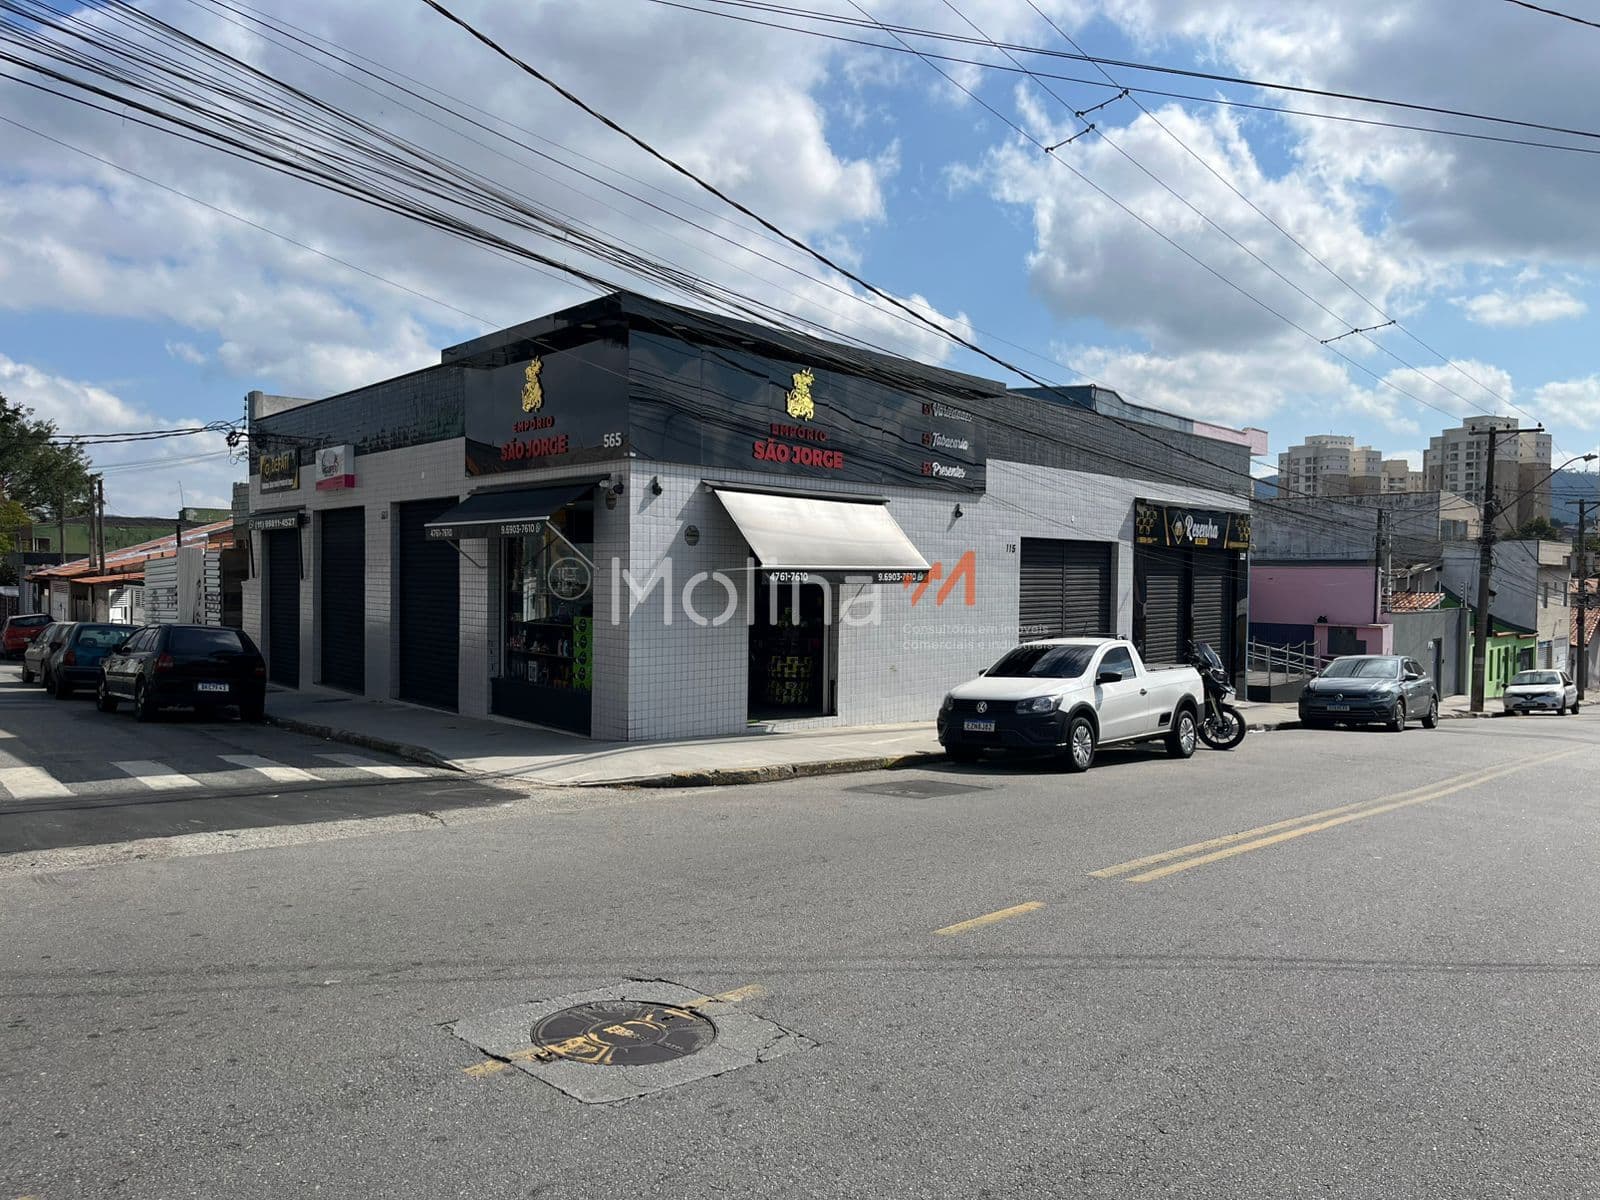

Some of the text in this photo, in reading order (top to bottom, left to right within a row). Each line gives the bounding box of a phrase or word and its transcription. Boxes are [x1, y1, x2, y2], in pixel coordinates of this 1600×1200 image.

[512, 416, 554, 433] EMPÓRIO
[501, 434, 568, 461] SÃO JORGE
[603, 432, 622, 448] 565
[932, 432, 969, 450] Tabacaria
[753, 437, 844, 470] SÃO JORGE
[932, 461, 967, 479] Presentes
[1185, 514, 1219, 541] Resenha
[1006, 543, 1016, 553] 115
[769, 572, 809, 582] 4761-7610
